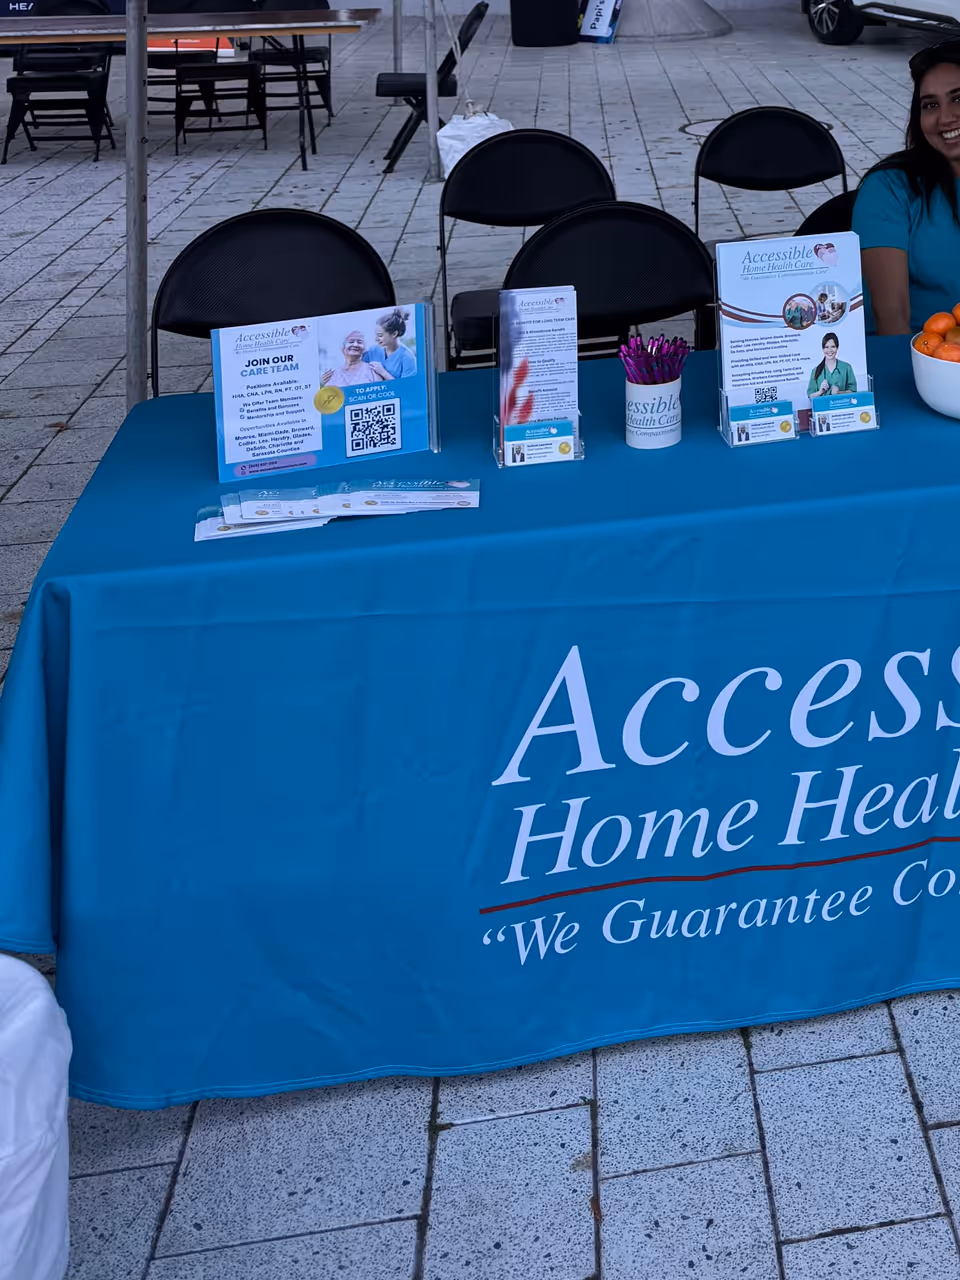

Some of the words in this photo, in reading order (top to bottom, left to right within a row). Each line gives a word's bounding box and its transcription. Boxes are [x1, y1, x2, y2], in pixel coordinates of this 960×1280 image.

[741, 245, 813, 264] Accessible
[240, 366, 268, 377] CARE
[270, 362, 299, 374] TEAM
[245, 357, 270, 368] JOIN
[272, 354, 294, 364] OUR
[627, 393, 679, 415] essible
[500, 794, 759, 884] Home
[481, 914, 580, 966] "We
[601, 880, 873, 946] Guarantee
